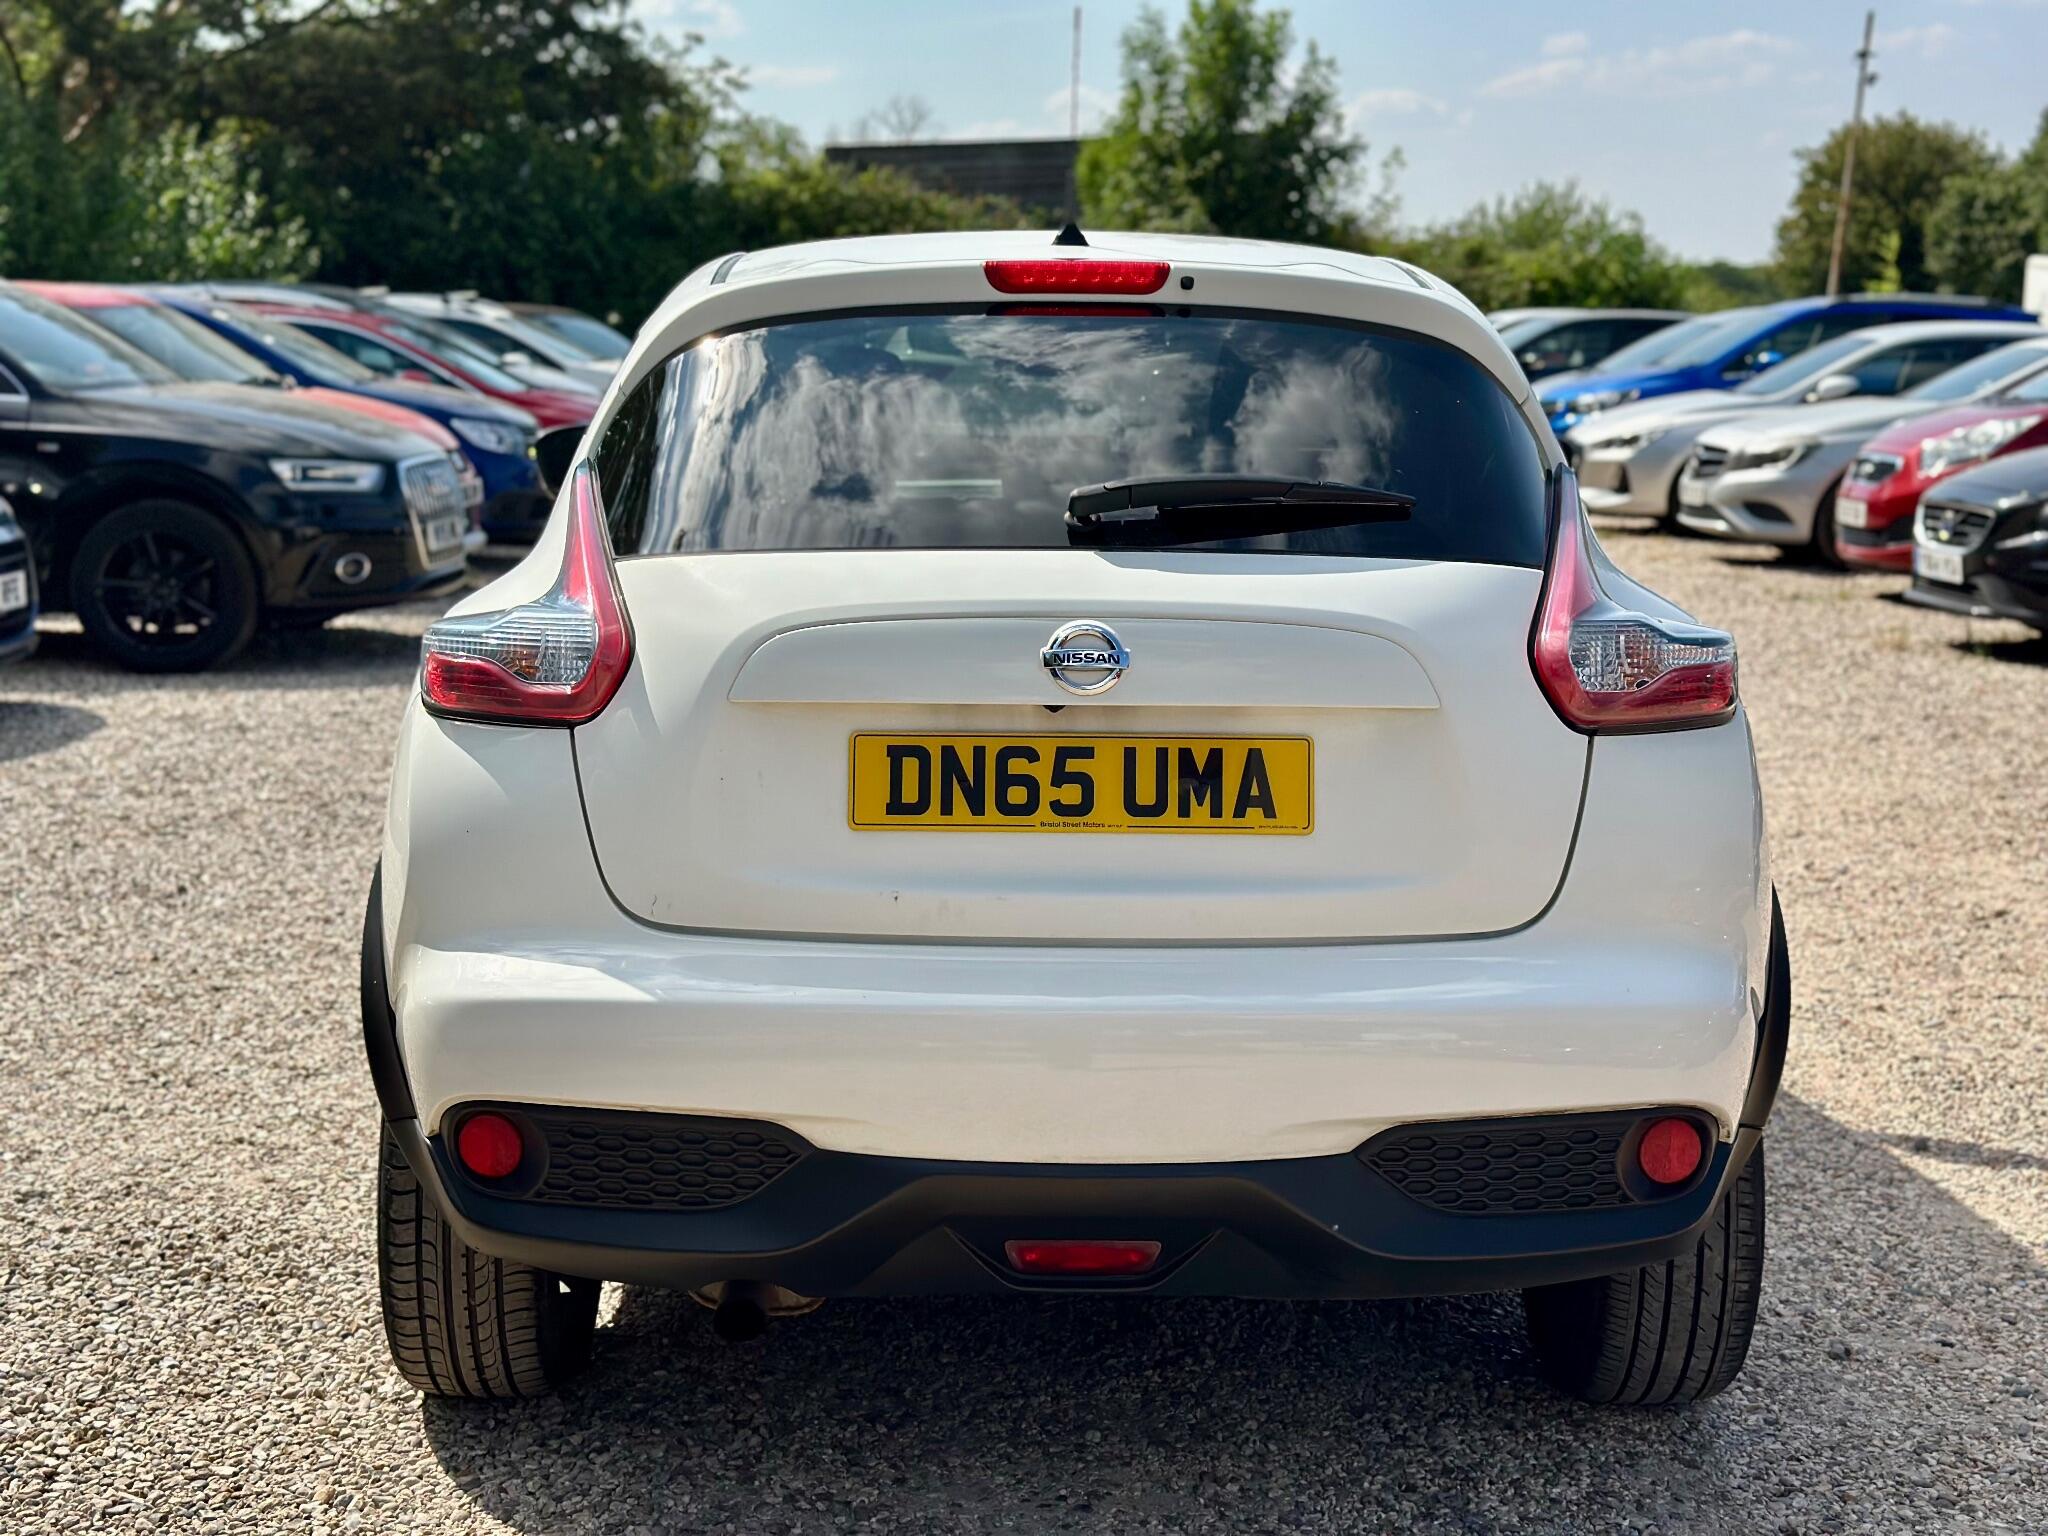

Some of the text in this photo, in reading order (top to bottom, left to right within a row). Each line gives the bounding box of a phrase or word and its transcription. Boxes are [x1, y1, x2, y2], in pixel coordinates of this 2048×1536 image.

[1053, 652, 1120, 665] NISSAN
[886, 745, 1277, 819] DN65 UMA
[1040, 820, 1060, 828] Bristol
[1062, 820, 1081, 828] Street
